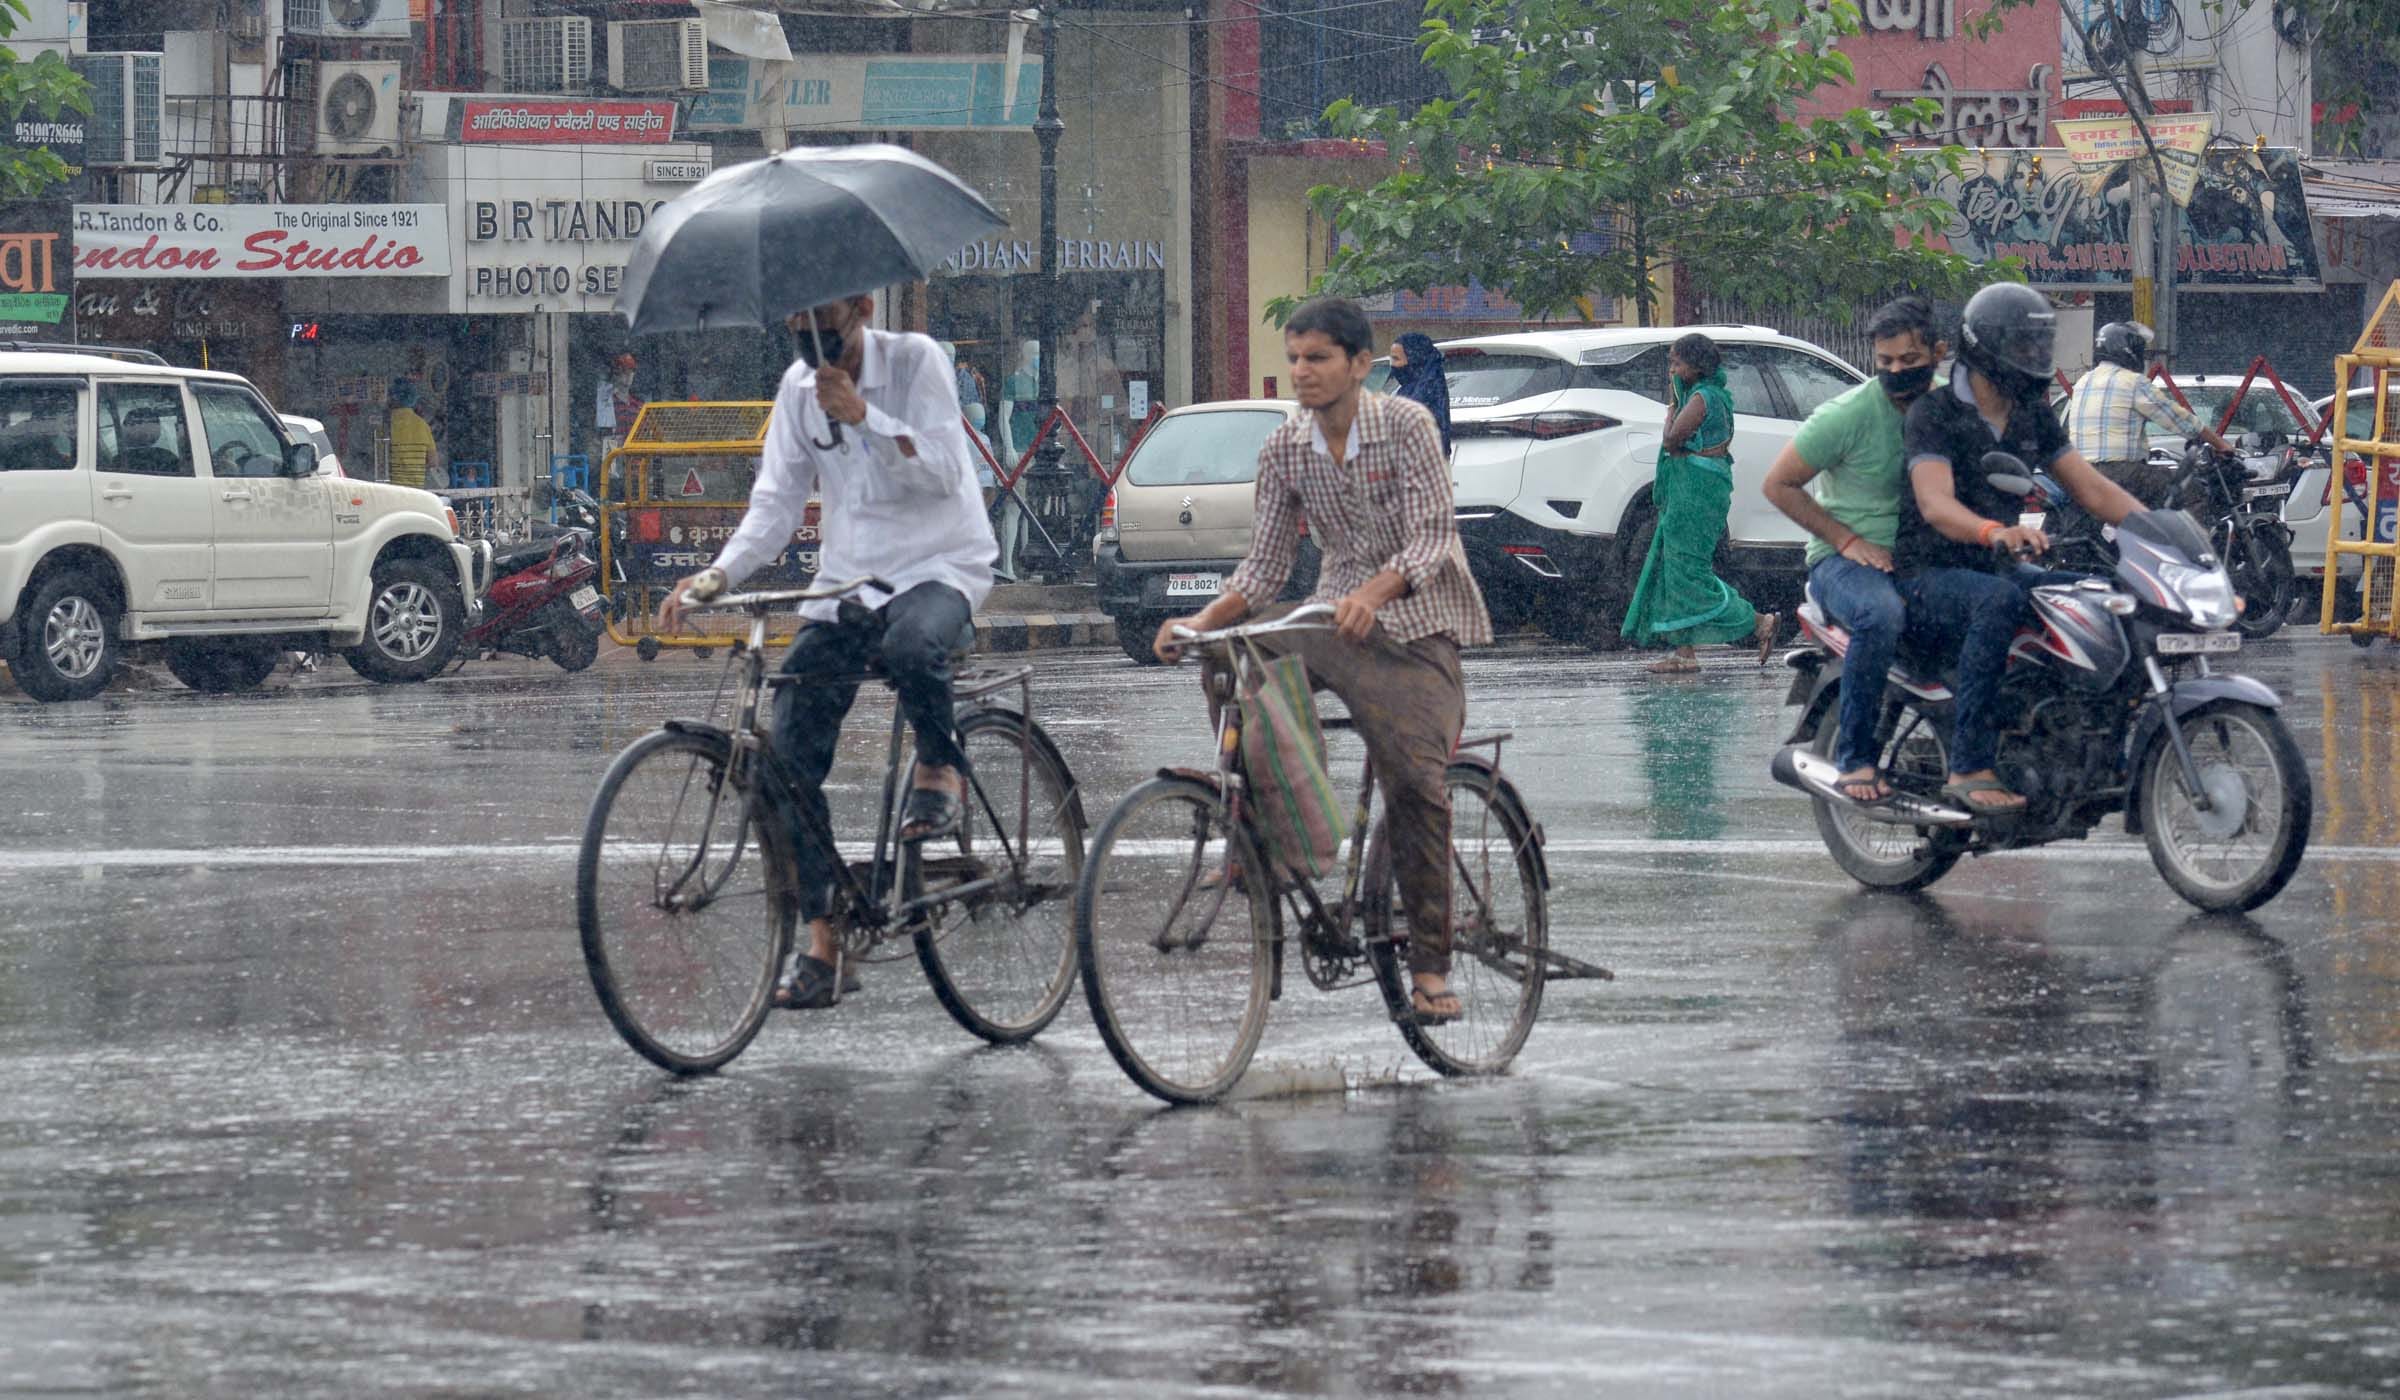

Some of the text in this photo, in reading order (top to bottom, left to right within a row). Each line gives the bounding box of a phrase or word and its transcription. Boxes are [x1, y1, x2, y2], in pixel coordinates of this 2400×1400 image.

[656, 164, 706, 178] SINCE 1921
[74, 211, 224, 231] .R.Tandon & Co.
[274, 210, 418, 232] The Original Since 1921
[545, 200, 668, 240] TAND
[236, 229, 424, 271] Studio
[937, 239, 1031, 270] NDIAN
[2176, 243, 2288, 271] OLLECTION
[476, 266, 570, 295] PHOTO
[1194, 579, 1218, 590] 8021
